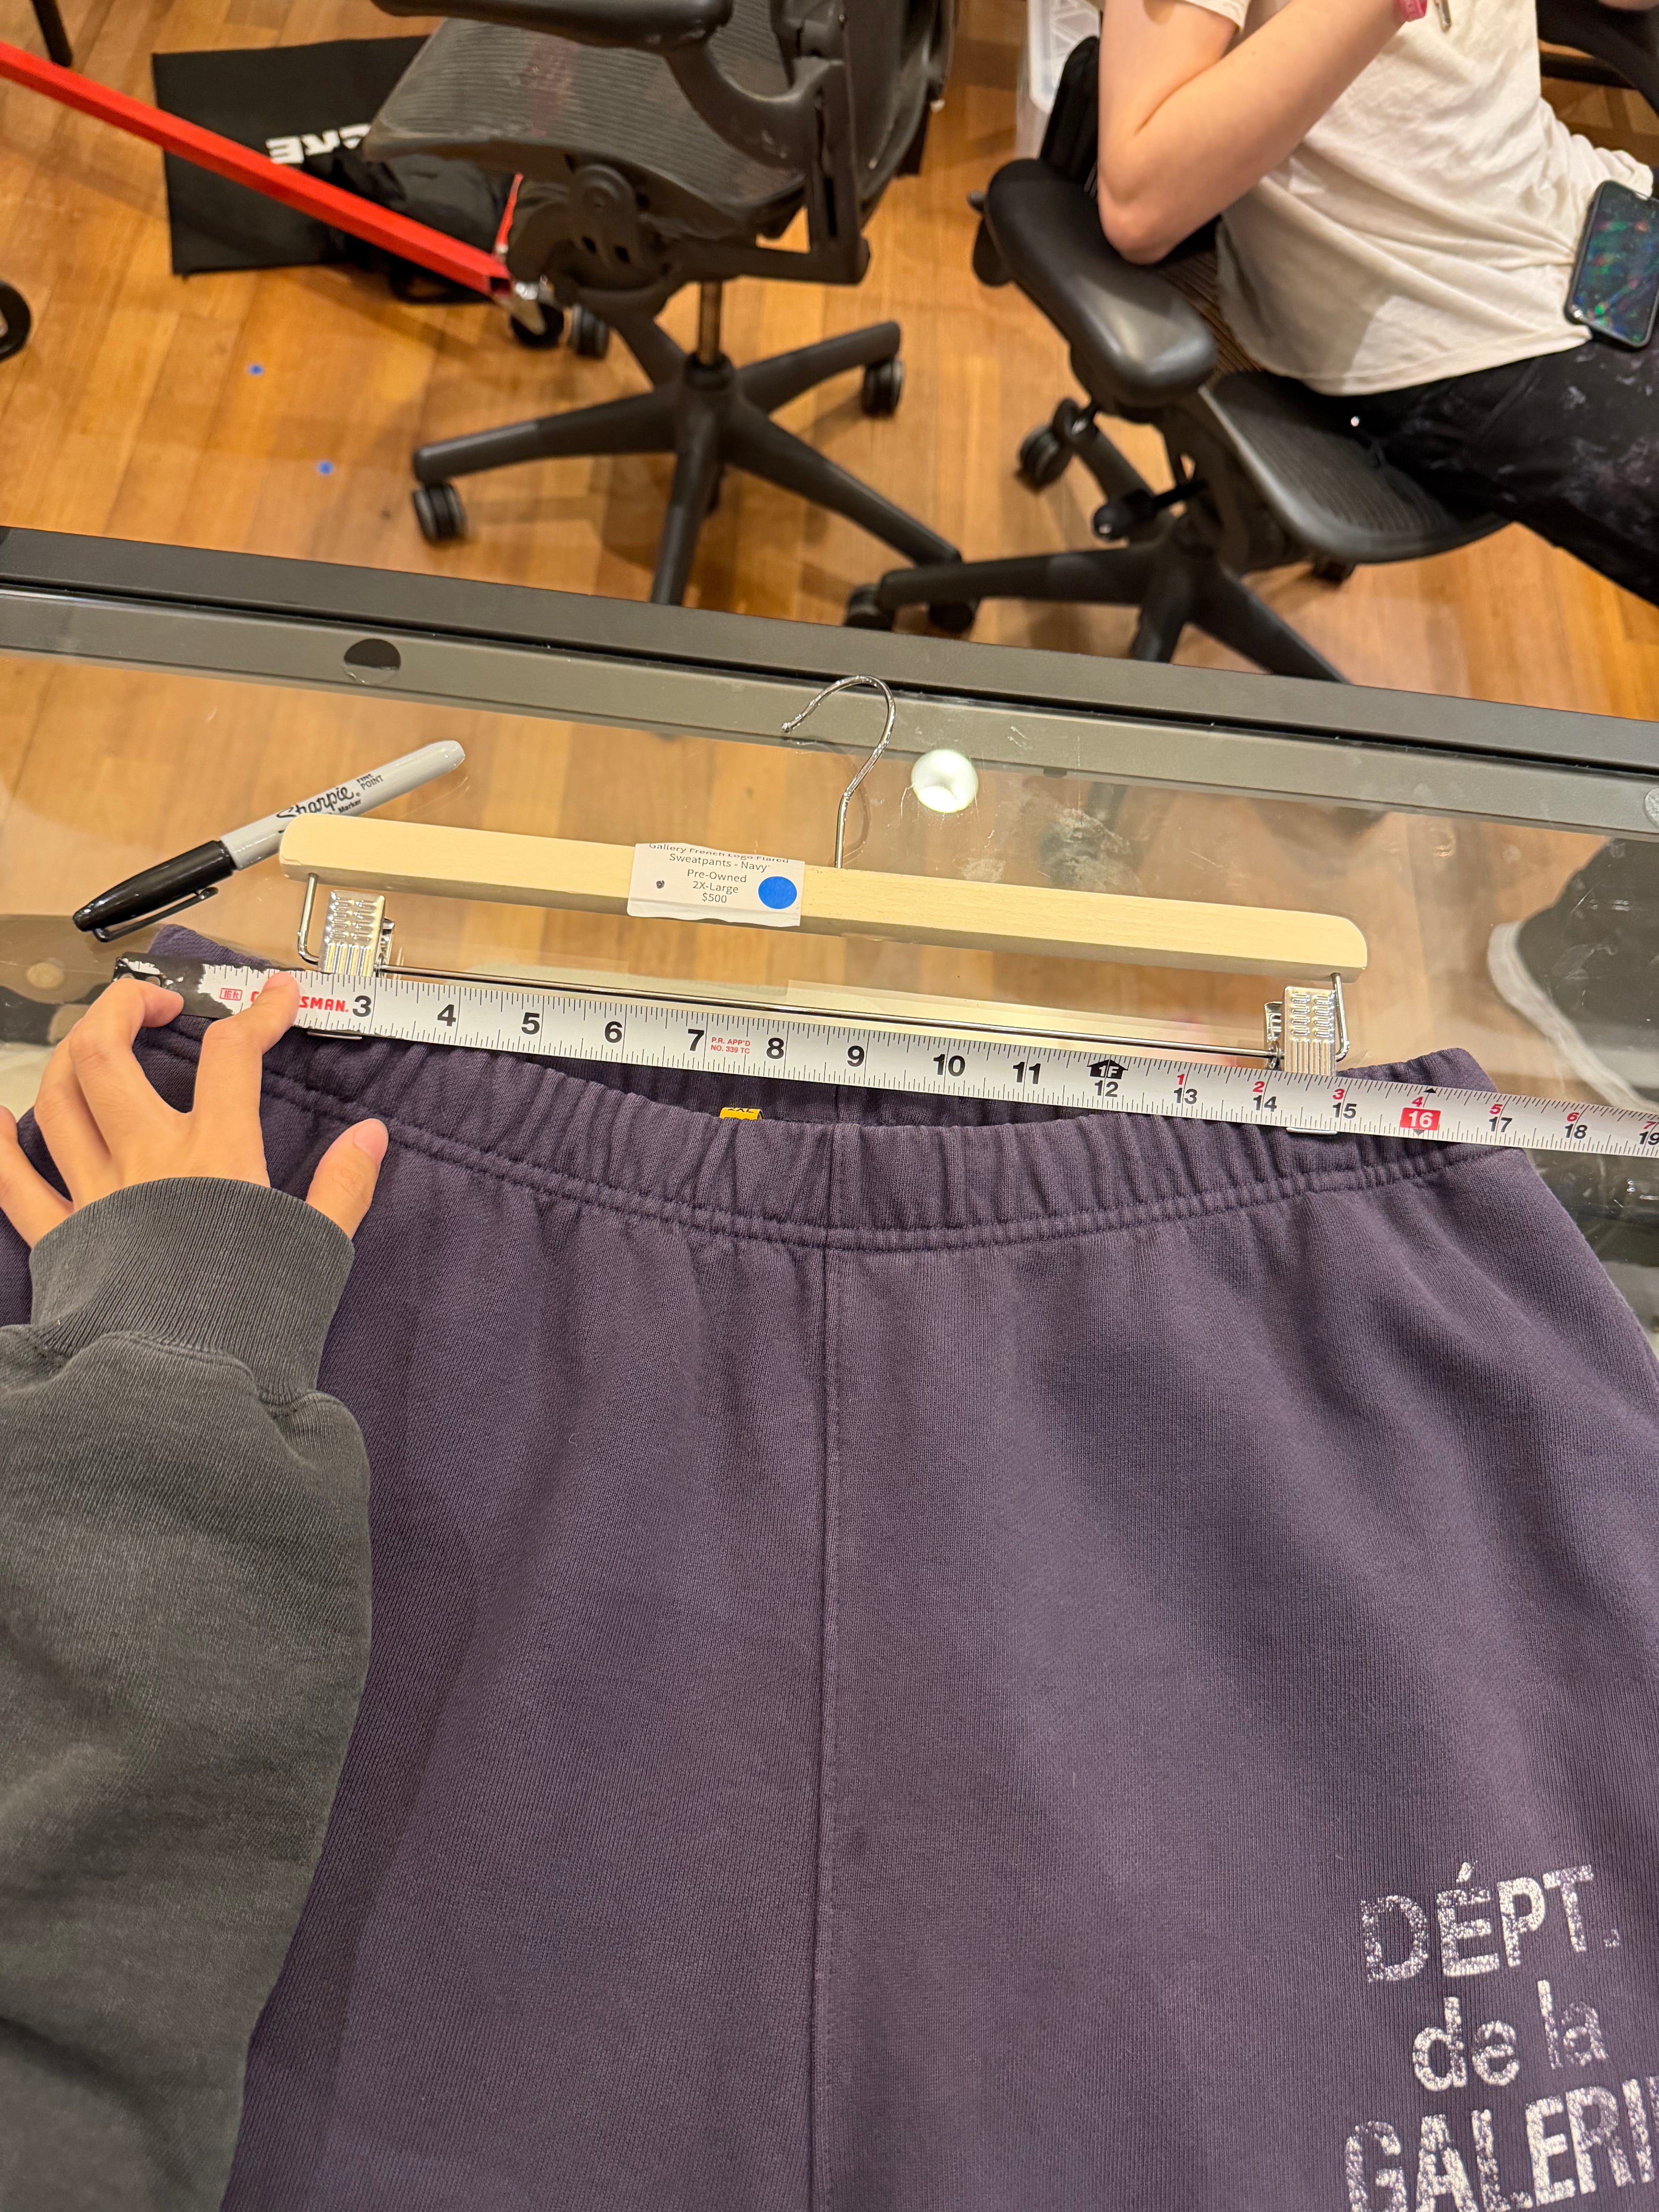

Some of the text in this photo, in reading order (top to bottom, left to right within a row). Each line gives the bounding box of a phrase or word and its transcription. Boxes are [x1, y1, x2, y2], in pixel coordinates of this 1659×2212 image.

[356, 773, 374, 783] FINE
[360, 775, 384, 790] POINT
[338, 799, 361, 814] Marker
[649, 843, 686, 853] Gallery
[690, 848, 725, 856] French
[670, 853, 731, 868] Sweatpants
[741, 861, 767, 873] Navy
[687, 869, 747, 883] Pre-Owned
[693, 881, 739, 895] 2X-Large
[702, 893, 727, 903] $500
[353, 995, 1659, 1145] 3 4 5 6 7 8 9 10 11 12 13 14 15 16 17 18 19
[1099, 1065, 1119, 1077] 1F
[1177, 1074, 1657, 1129] 1 2 3 4 5 6 7
[1360, 1860, 1620, 1983] DÉPT.
[1412, 1979, 1608, 2091] de la
[1344, 2075, 1659, 2212] GALERI
